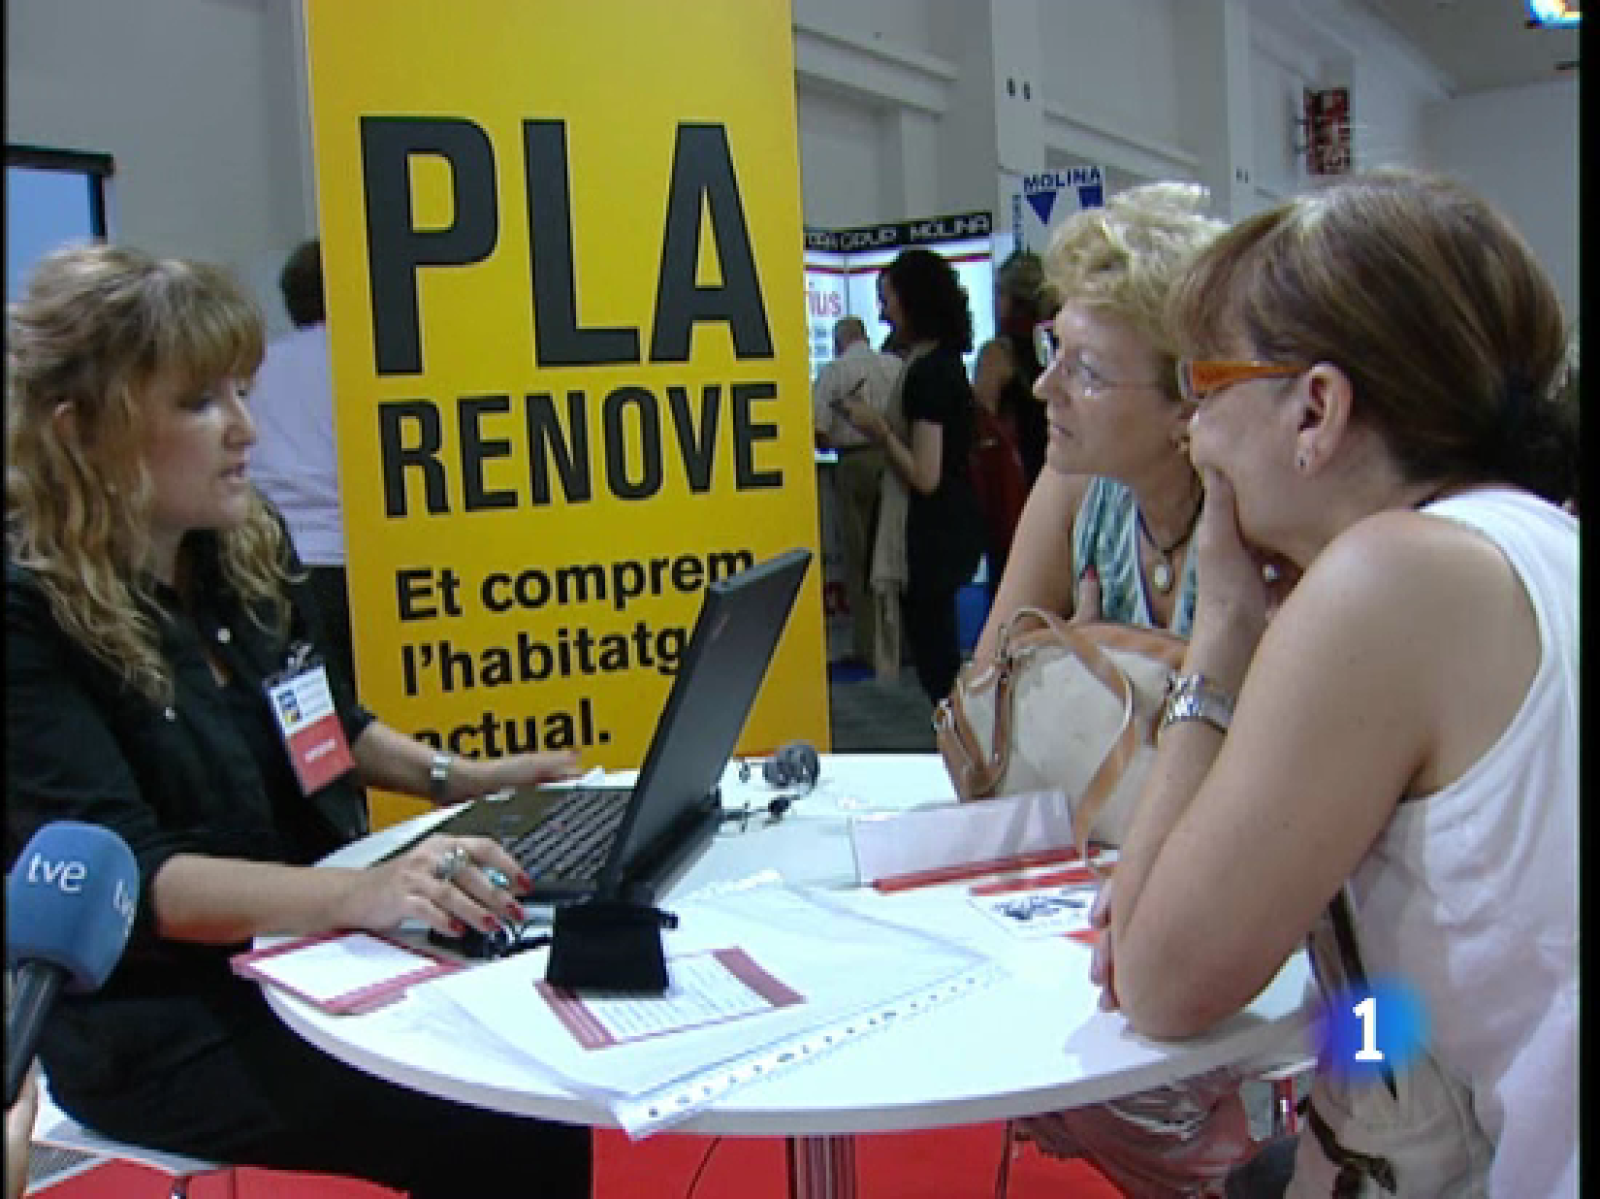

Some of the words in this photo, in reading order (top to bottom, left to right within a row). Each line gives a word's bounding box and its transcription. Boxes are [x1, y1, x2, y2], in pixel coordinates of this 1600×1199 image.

[1023, 166, 1101, 192] MOLINA
[361, 116, 774, 376] PLA
[909, 215, 989, 242] MOLINA
[378, 381, 783, 517] RENOVE
[396, 567, 462, 622] Et
[481, 549, 754, 612] comprem
[27, 852, 88, 892] tve
